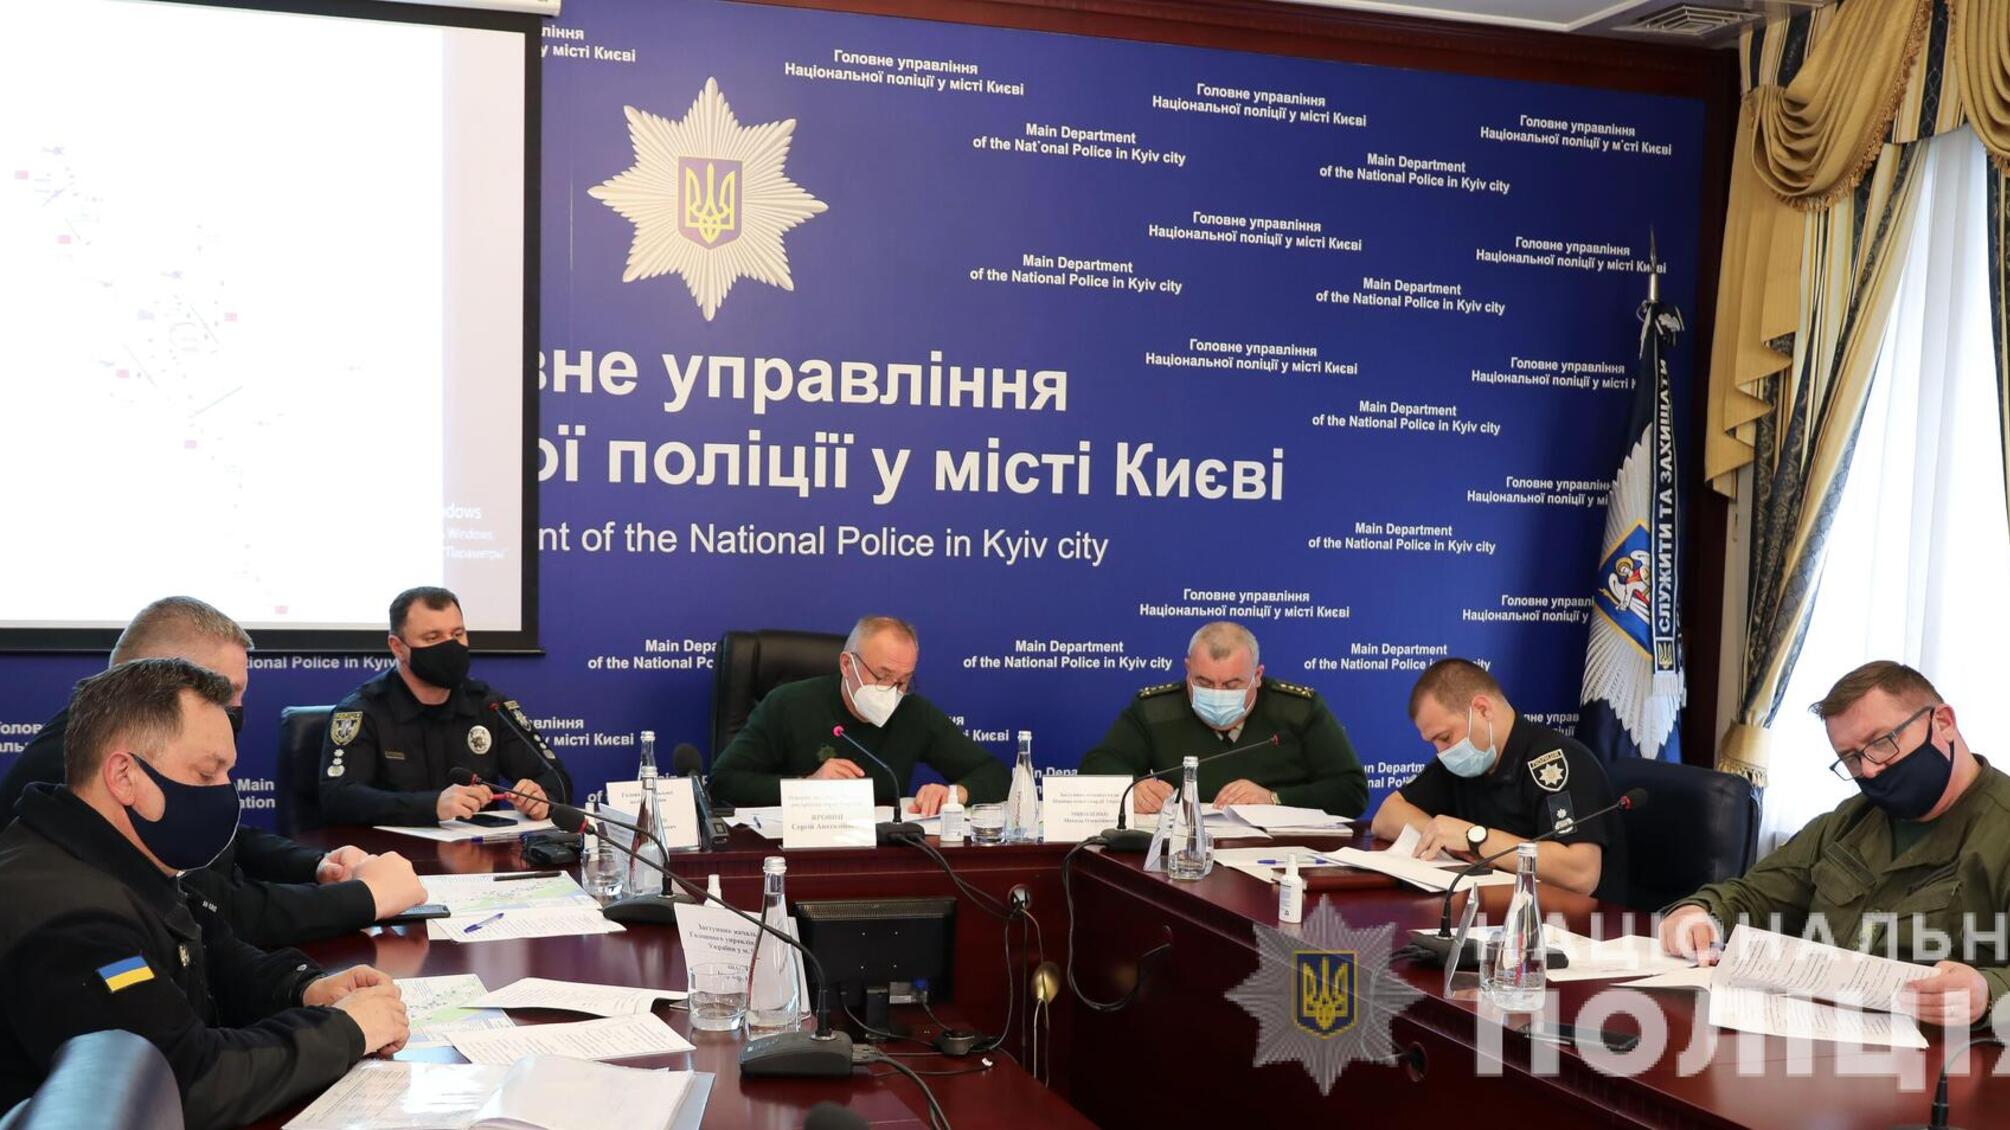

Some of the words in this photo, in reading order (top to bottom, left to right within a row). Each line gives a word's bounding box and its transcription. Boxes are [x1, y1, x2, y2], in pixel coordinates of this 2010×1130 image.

[552, 43, 590, 59] місті
[594, 45, 636, 63] Києві
[834, 49, 894, 67] Головне
[897, 57, 978, 75] управління
[784, 61, 885, 83] Національної
[886, 73, 936, 89] поліції
[949, 77, 983, 92] місті
[986, 79, 1024, 96] Києві
[1196, 82, 1251, 100] Головне
[1253, 90, 1326, 107] управління
[1152, 94, 1242, 115] Національної
[1243, 105, 1288, 121] поліції
[1299, 109, 1330, 124] місті
[1333, 111, 1367, 127] Києві
[1025, 122, 1058, 138] Main
[1060, 125, 1137, 144] Department
[1519, 114, 1569, 131] Головне
[1570, 121, 1636, 137] управління
[972, 135, 988, 149] of
[989, 136, 1012, 151] the
[1014, 138, 1069, 155] Natonal
[1072, 143, 1113, 159] Police
[1115, 146, 1128, 160] in
[1131, 147, 1160, 164] Kyiv
[1162, 151, 1186, 167] city
[1480, 126, 1560, 145] Національної
[1561, 135, 1601, 150] поліції
[1611, 139, 1639, 153] мсті
[1641, 141, 1672, 156] Києві
[1367, 152, 1396, 167] Main
[1398, 155, 1466, 174] Department
[1319, 164, 1333, 178] of
[1334, 166, 1354, 180] the
[1356, 167, 1406, 184] National
[1408, 171, 1445, 187] Police
[1447, 175, 1458, 188] in
[1461, 176, 1487, 192] Kyiv
[1488, 179, 1510, 195] city
[1363, 277, 1392, 291] Main
[1394, 279, 1462, 296] Department
[1315, 290, 1329, 302] of
[1330, 290, 1350, 304] the
[1352, 292, 1402, 307] National
[1404, 295, 1440, 310] Police
[1442, 297, 1454, 310] in
[1456, 298, 1482, 314] Kyiv
[1484, 301, 1506, 316] city
[1189, 338, 1243, 353] Головне
[1245, 343, 1318, 359] управління
[1145, 351, 1234, 369] Національної
[1236, 357, 1280, 372] поліції
[1291, 359, 1322, 373] місті
[1324, 361, 1358, 375] Києві
[1510, 356, 1559, 371] Головне
[1560, 361, 1625, 376] управління
[661, 350, 1068, 413] управління
[1471, 369, 1551, 385] Національної
[1552, 375, 1591, 389] поліції
[1602, 377, 1629, 389] місті
[608, 429, 855, 498] поліції
[871, 448, 911, 505] у
[935, 437, 1091, 495] місті
[1115, 441, 1284, 501] Києві
[1505, 475, 1554, 490] Головне
[1466, 489, 1545, 506] Національної
[1547, 493, 1586, 507] поліції
[1658, 488, 1672, 519] ТА
[1354, 522, 1383, 535] Main
[1385, 522, 1453, 539] Department
[581, 520, 616, 552] of
[624, 522, 678, 553] the
[690, 523, 825, 555] National
[838, 525, 935, 557] Police
[945, 527, 971, 557] in
[983, 528, 1048, 566] Kyiv
[1057, 530, 1109, 567] city
[1308, 536, 1321, 549] of
[1323, 536, 1342, 549] the
[1345, 537, 1393, 550] National
[1395, 538, 1432, 551] Police
[1433, 539, 1445, 551] in
[1447, 539, 1473, 554] Kyiv
[1475, 540, 1496, 556] city
[1658, 523, 1672, 633] СЛУЖИТИ
[1183, 588, 1237, 602] Головне
[1238, 590, 1310, 604] управління
[1501, 594, 1549, 607] Головне
[1139, 603, 1227, 618] Національної
[1229, 604, 1272, 619] поліції
[1284, 605, 1314, 618] місті
[1316, 605, 1350, 618] Києві
[1462, 608, 1540, 624] Національної
[1542, 612, 1580, 625] поліції
[645, 639, 680, 653] Main
[1015, 639, 1047, 653] Main
[1049, 640, 1124, 655] Department
[1350, 642, 1379, 655] Main
[1381, 643, 1448, 657] Department
[292, 656, 340, 669] Police
[345, 656, 359, 669] in
[587, 655, 604, 670] of
[606, 656, 630, 670] the
[633, 655, 693, 669] National
[963, 655, 978, 668] of
[979, 655, 1001, 668] the
[1004, 655, 1058, 669] National
[1060, 655, 1101, 669] Police
[1103, 655, 1116, 668] in
[1118, 656, 1147, 671] Kyiv
[1149, 656, 1173, 671] city
[1303, 657, 1317, 670] of
[1319, 657, 1338, 670] the
[1340, 657, 1389, 670] National
[1391, 657, 1427, 670] Police
[0, 721, 43, 735] олов
[531, 716, 585, 730] вління
[553, 732, 590, 746] місті
[593, 732, 635, 746] Києві
[972, 729, 1010, 742] Києві
[237, 778, 275, 791] Main
